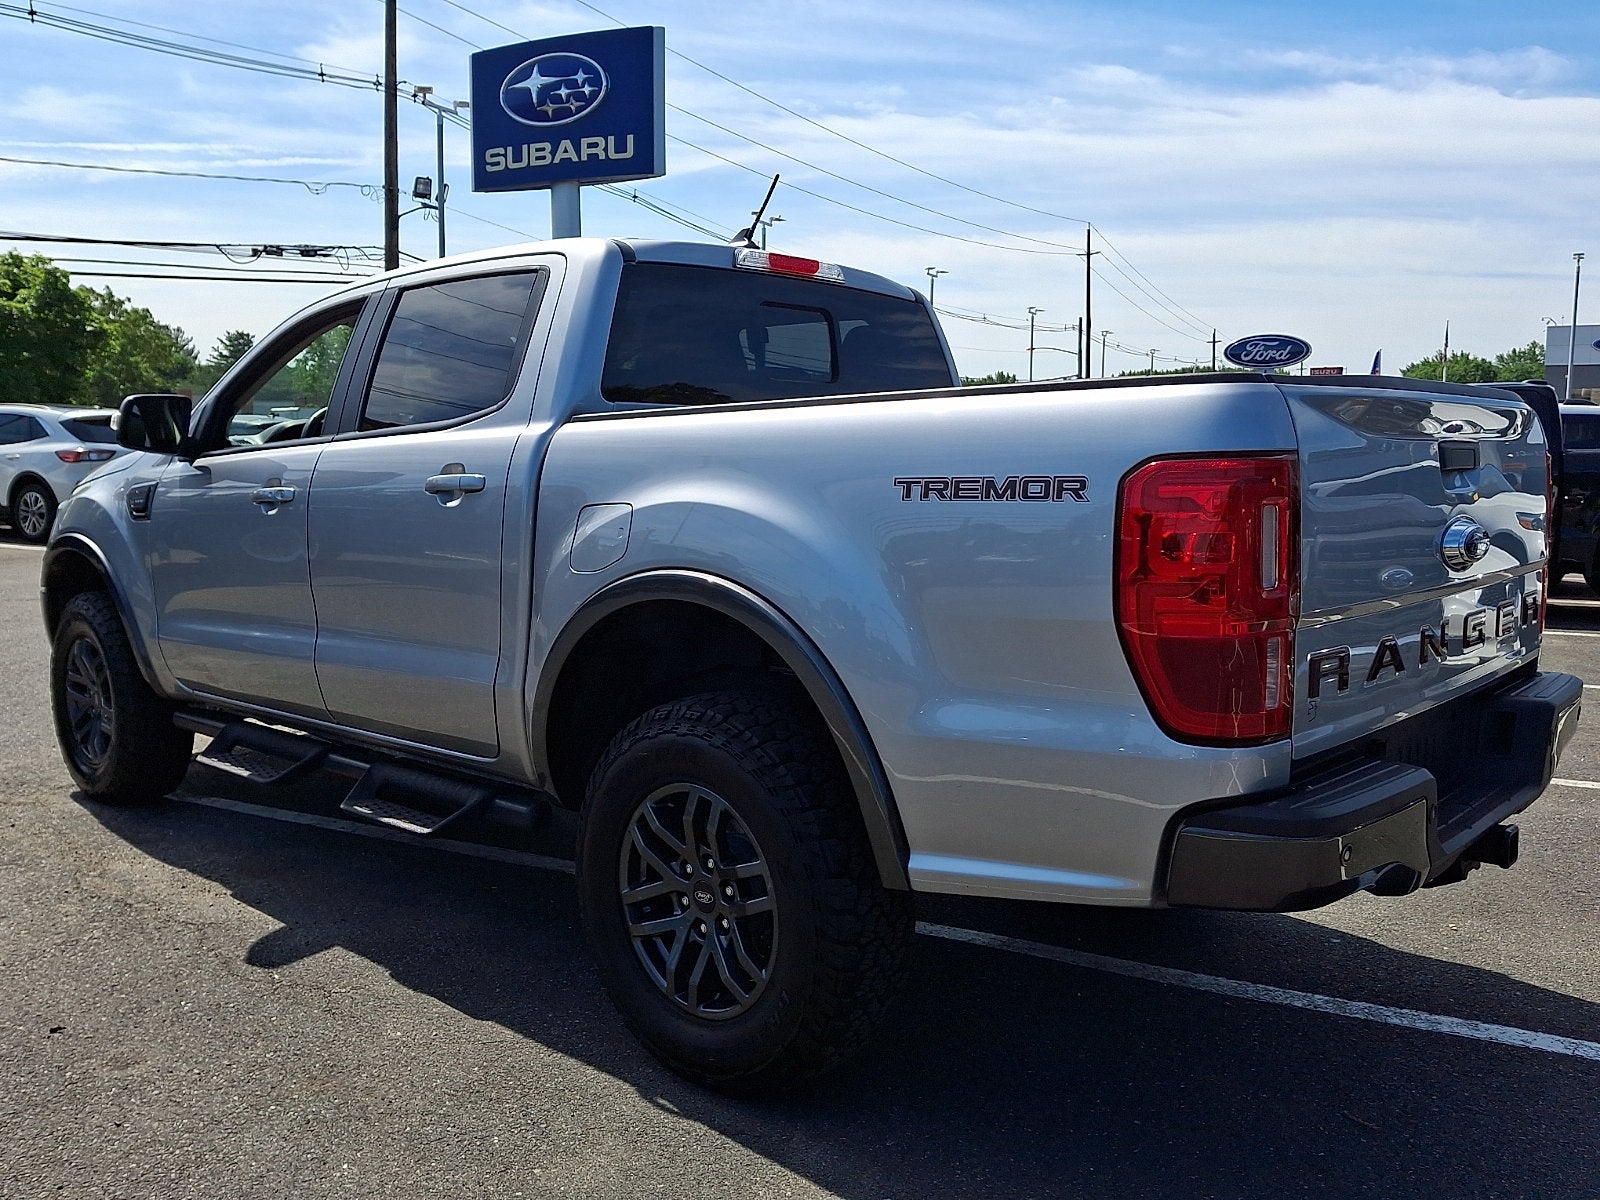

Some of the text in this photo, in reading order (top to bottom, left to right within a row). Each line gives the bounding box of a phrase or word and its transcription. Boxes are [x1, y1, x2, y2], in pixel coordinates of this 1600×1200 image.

[485, 134, 634, 173] SUBARU
[1241, 341, 1292, 361] Ford
[893, 475, 1090, 503] TREMOR
[1307, 591, 1538, 700] RANGER
